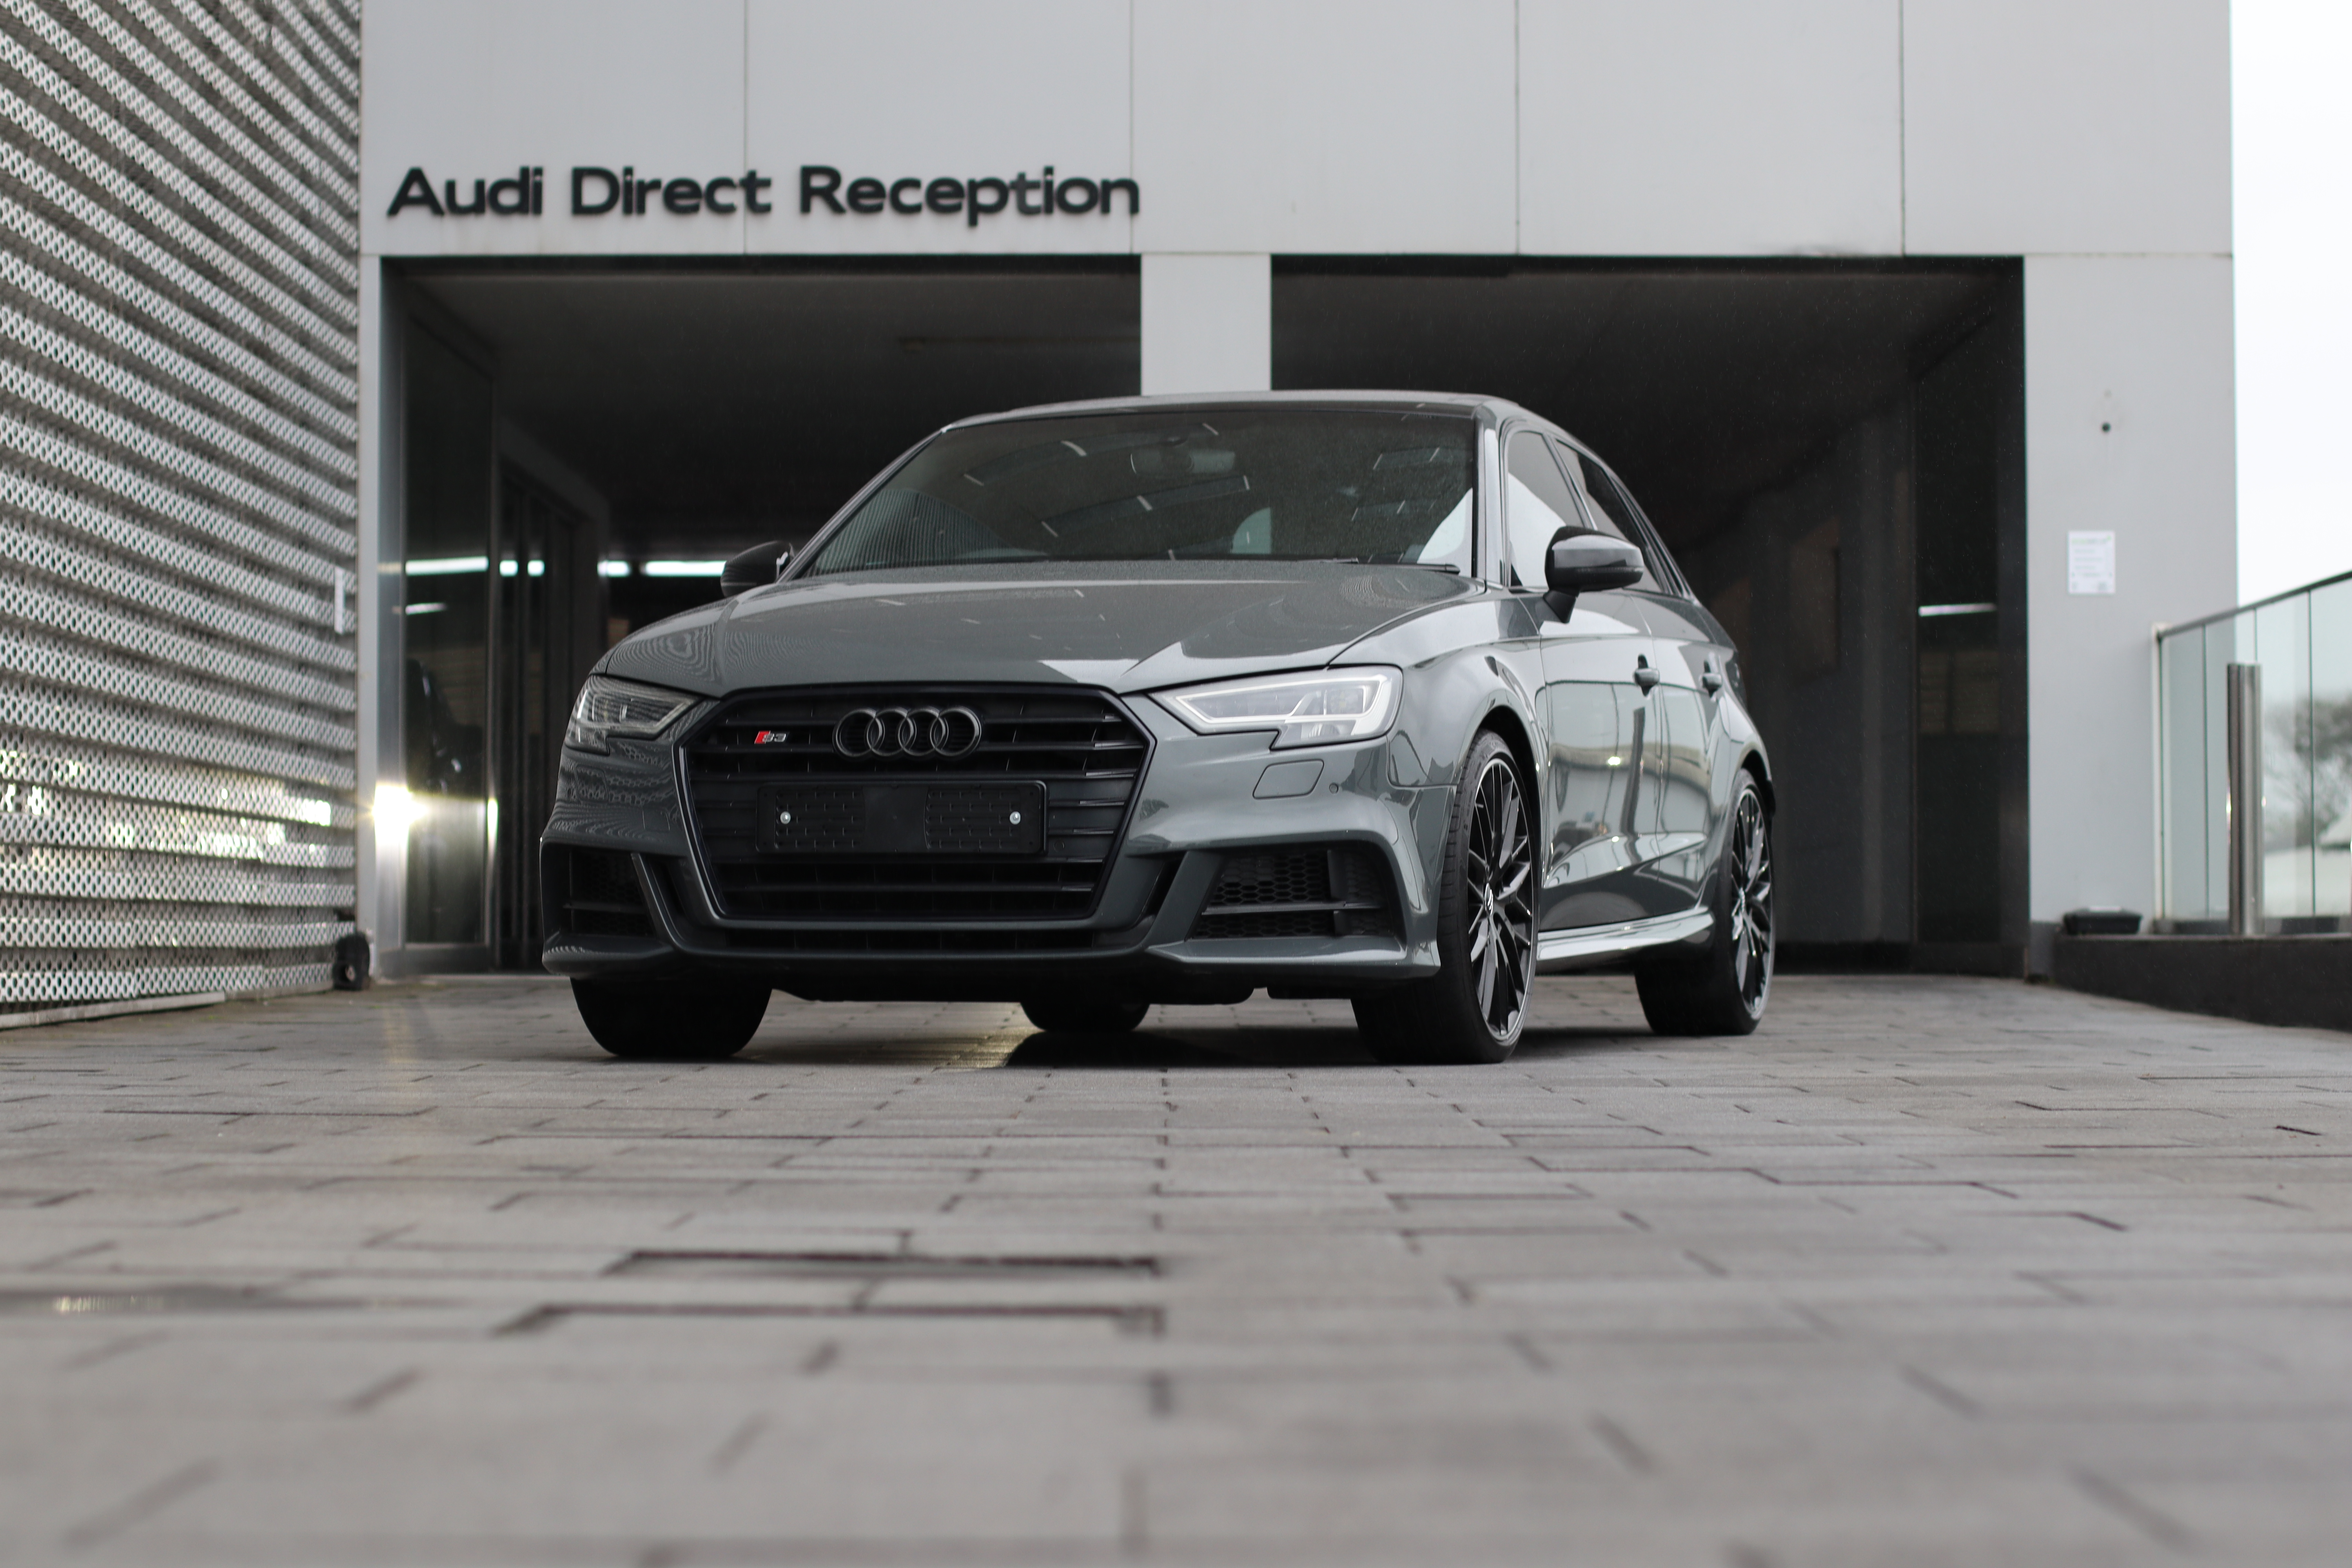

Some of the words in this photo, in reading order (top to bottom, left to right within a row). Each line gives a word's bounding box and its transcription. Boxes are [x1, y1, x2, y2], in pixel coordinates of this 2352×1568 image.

[387, 166, 544, 218] Audi
[571, 166, 772, 218] Direct
[799, 165, 1140, 229] Reception
